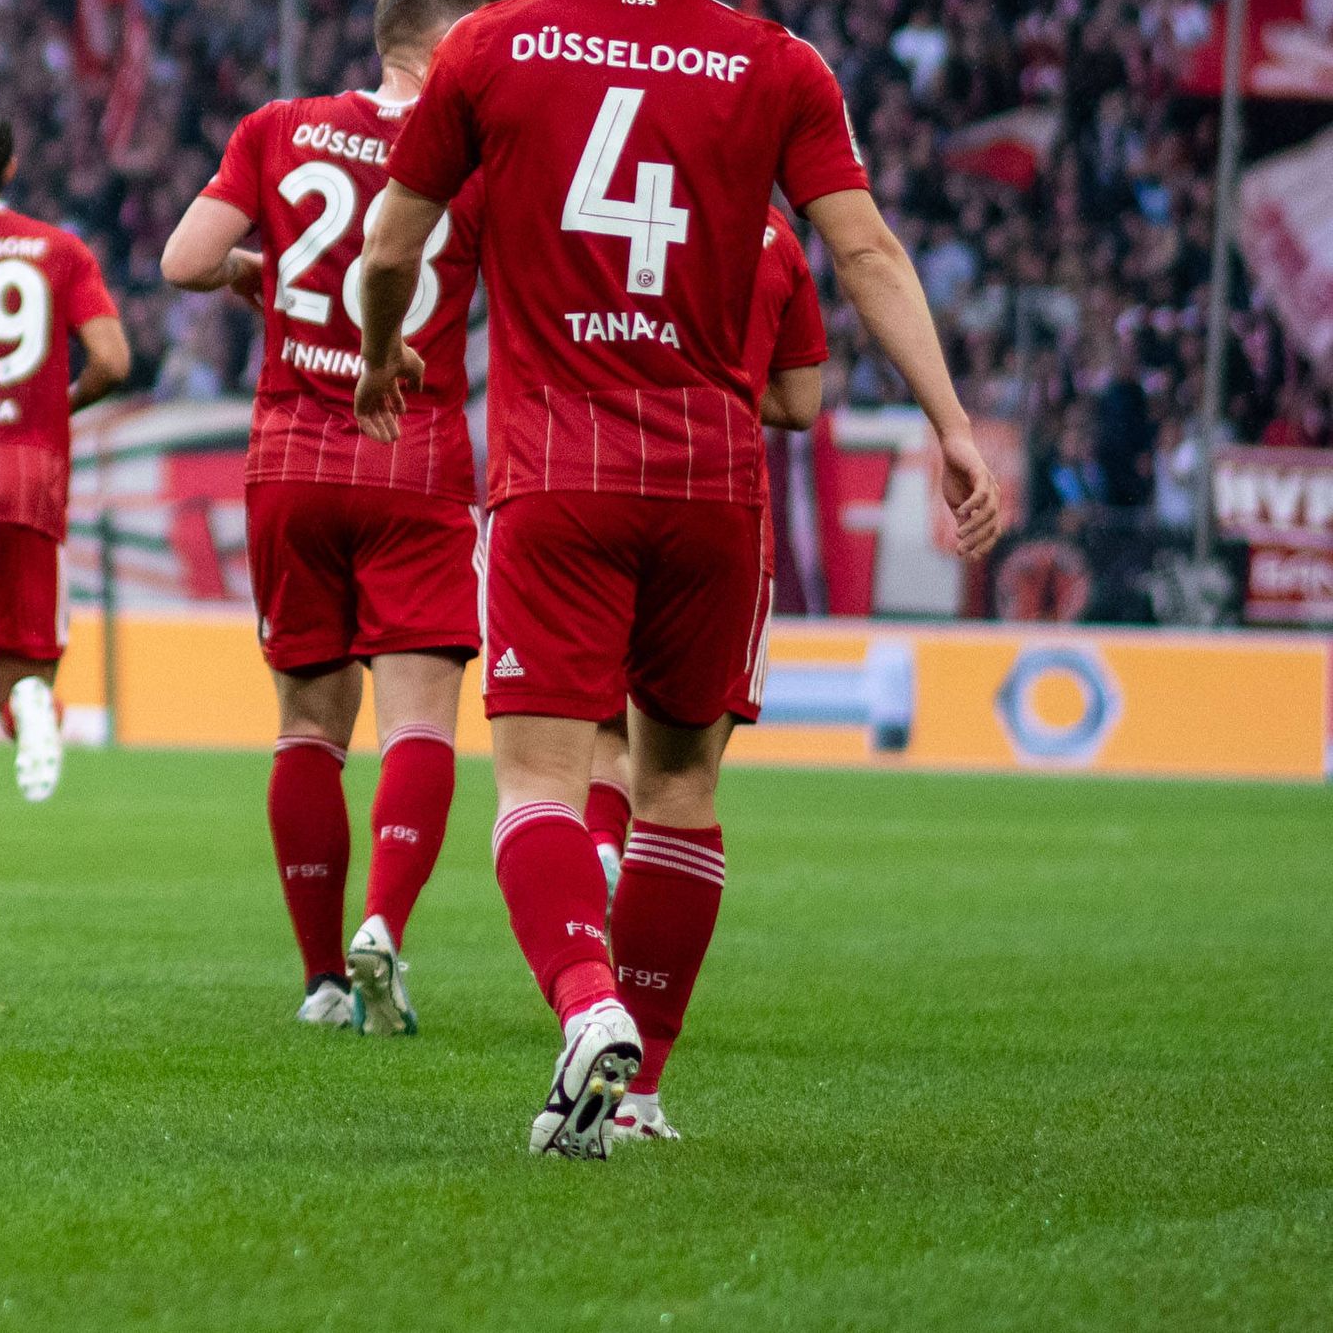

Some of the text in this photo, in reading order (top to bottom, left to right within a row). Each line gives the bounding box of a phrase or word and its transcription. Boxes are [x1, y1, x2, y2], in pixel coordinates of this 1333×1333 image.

[511, 26, 750, 83] DÜSSELDORF
[292, 123, 389, 164] DÜSSEL
[561, 87, 690, 296] 4
[565, 311, 680, 349] TANAA
[380, 824, 420, 844] F95
[285, 863, 328, 879] F95
[617, 964, 670, 991] F95
